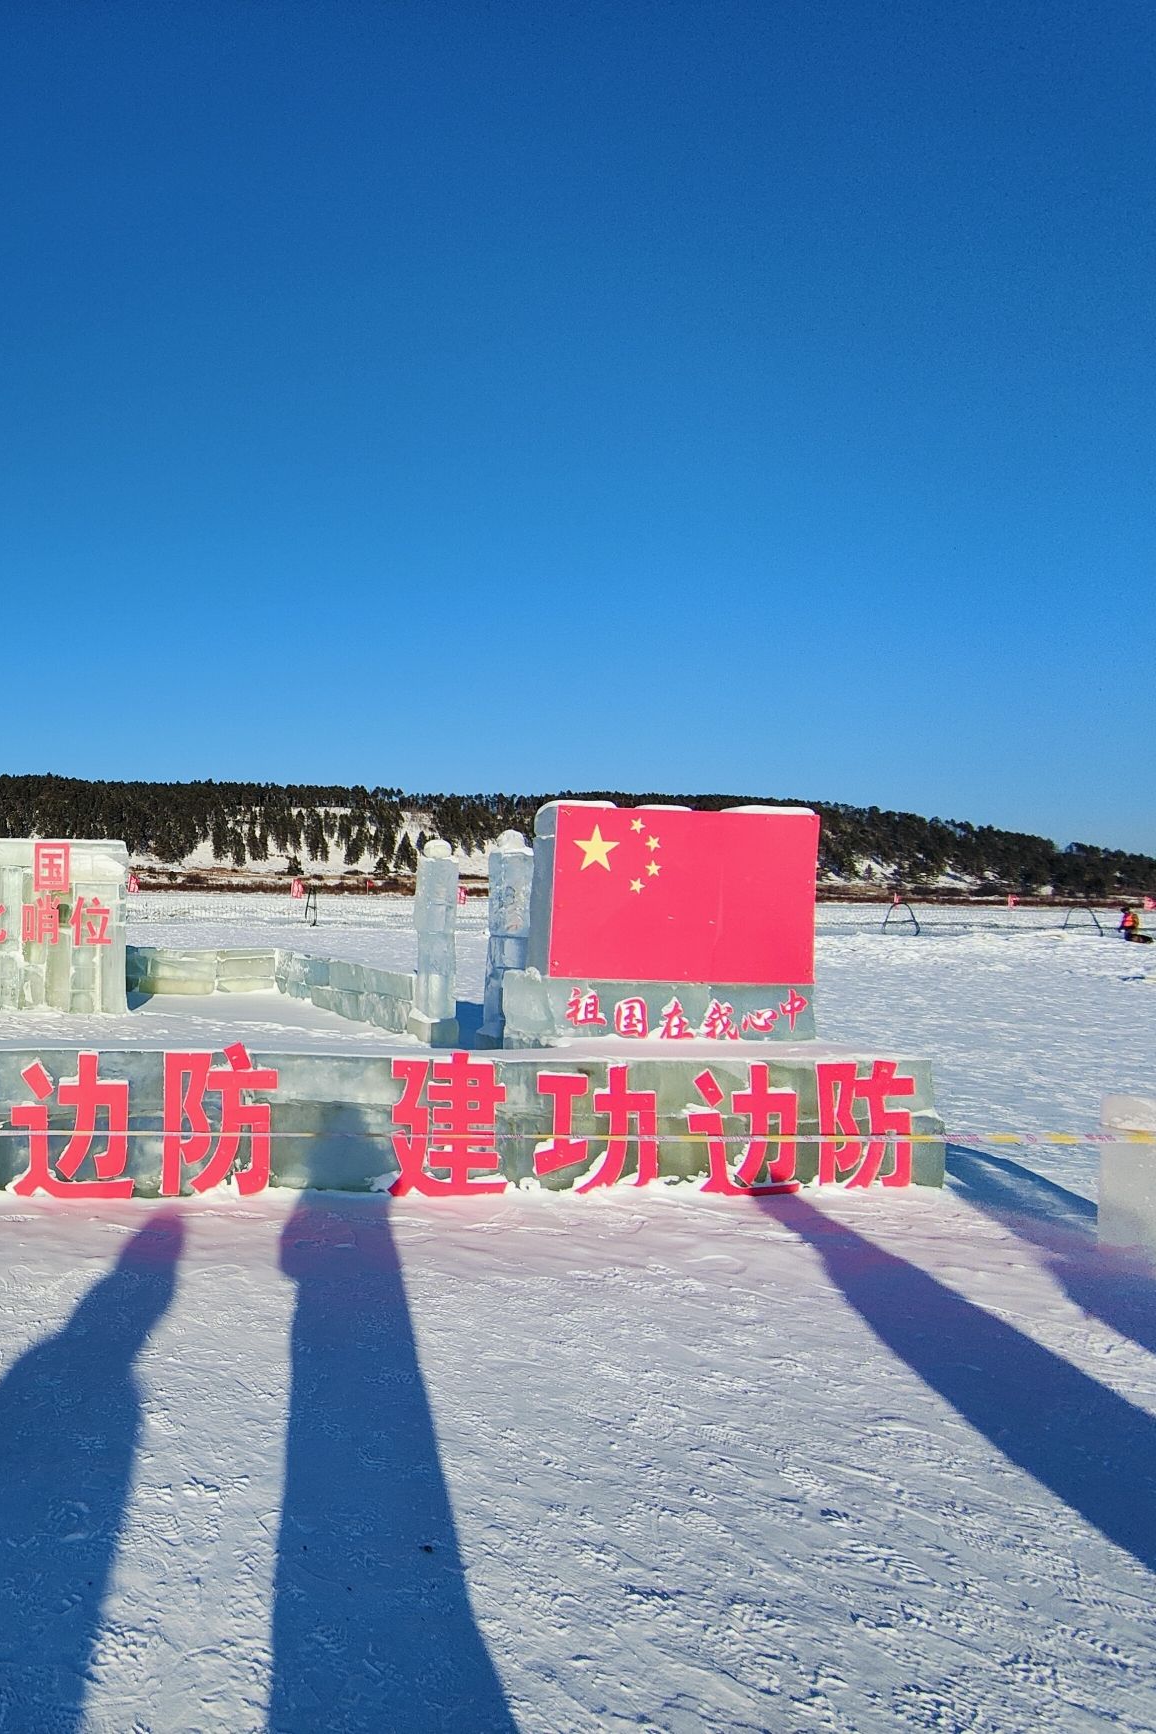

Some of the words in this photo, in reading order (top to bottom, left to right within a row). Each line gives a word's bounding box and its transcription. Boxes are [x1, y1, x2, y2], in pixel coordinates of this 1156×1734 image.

[565, 987, 807, 1040] 祖国在我心中
[389, 1052, 915, 1196] 建功边防
